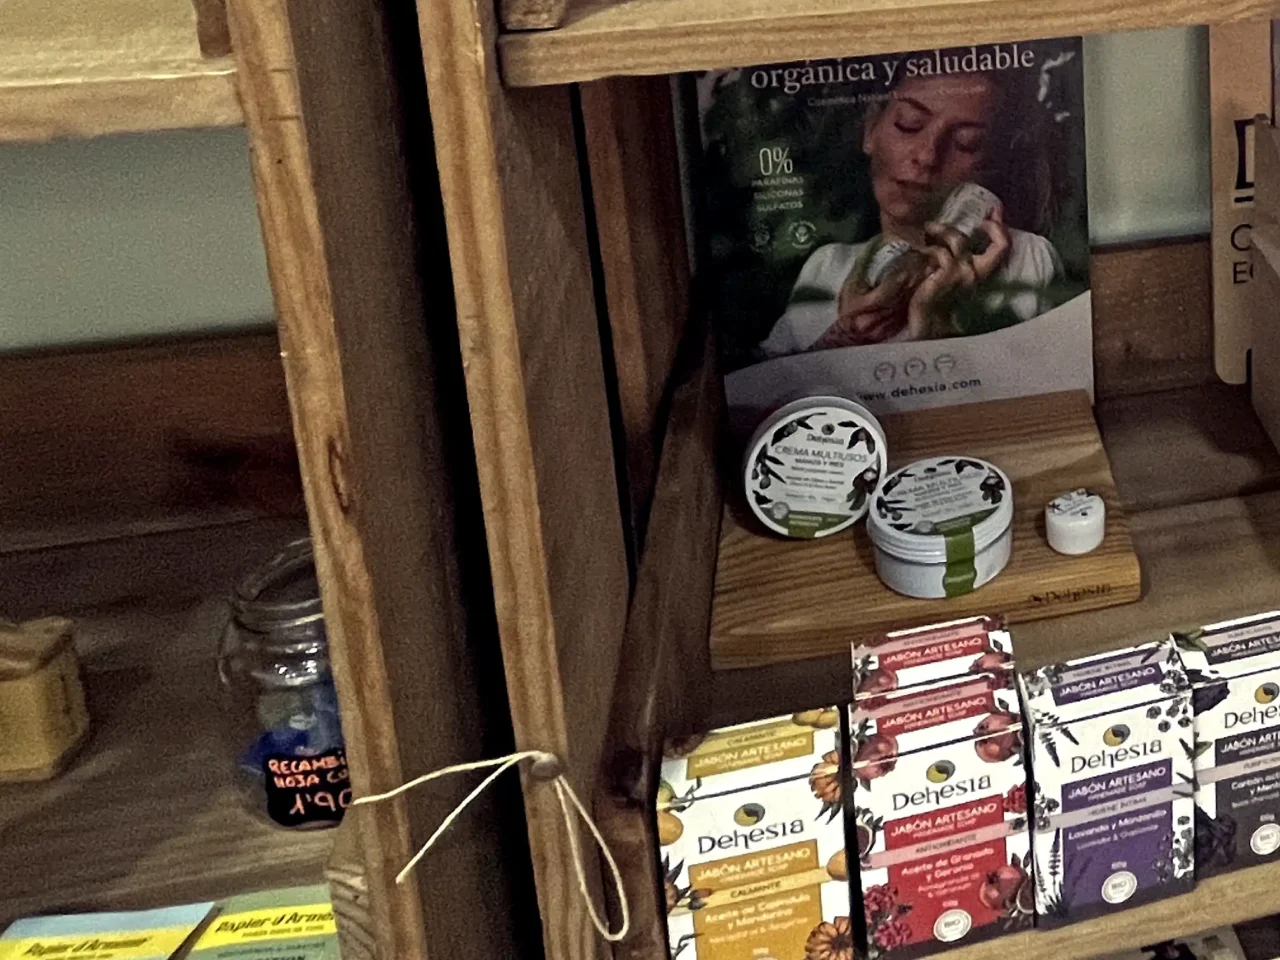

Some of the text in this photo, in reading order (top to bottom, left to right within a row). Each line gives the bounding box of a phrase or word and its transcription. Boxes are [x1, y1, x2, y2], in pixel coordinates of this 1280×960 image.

[752, 45, 1035, 92] orgánica y saludable
[760, 148, 793, 175] 0%
[757, 201, 803, 212] SULFATOS
[775, 445, 809, 456] CREMA
[883, 638, 981, 665] JABÓN ARTESANO
[1211, 642, 1246, 657] JABÓN
[1059, 666, 1155, 696] JABÓN ARTESANO
[882, 697, 986, 728] JABÓN ARTESANO
[695, 738, 806, 767] JABÓN ARTESANO
[1071, 739, 1163, 774] Dehesia
[1221, 738, 1256, 753] JABÓN
[892, 774, 992, 811] Dehesia
[1068, 767, 1166, 799] JABÓN ARTESANO
[891, 803, 997, 836] JABÓN ARTESANO
[698, 819, 804, 854] Dehesia
[697, 848, 810, 879] JABÓN ARTESANO
[215, 916, 271, 934] Papier
